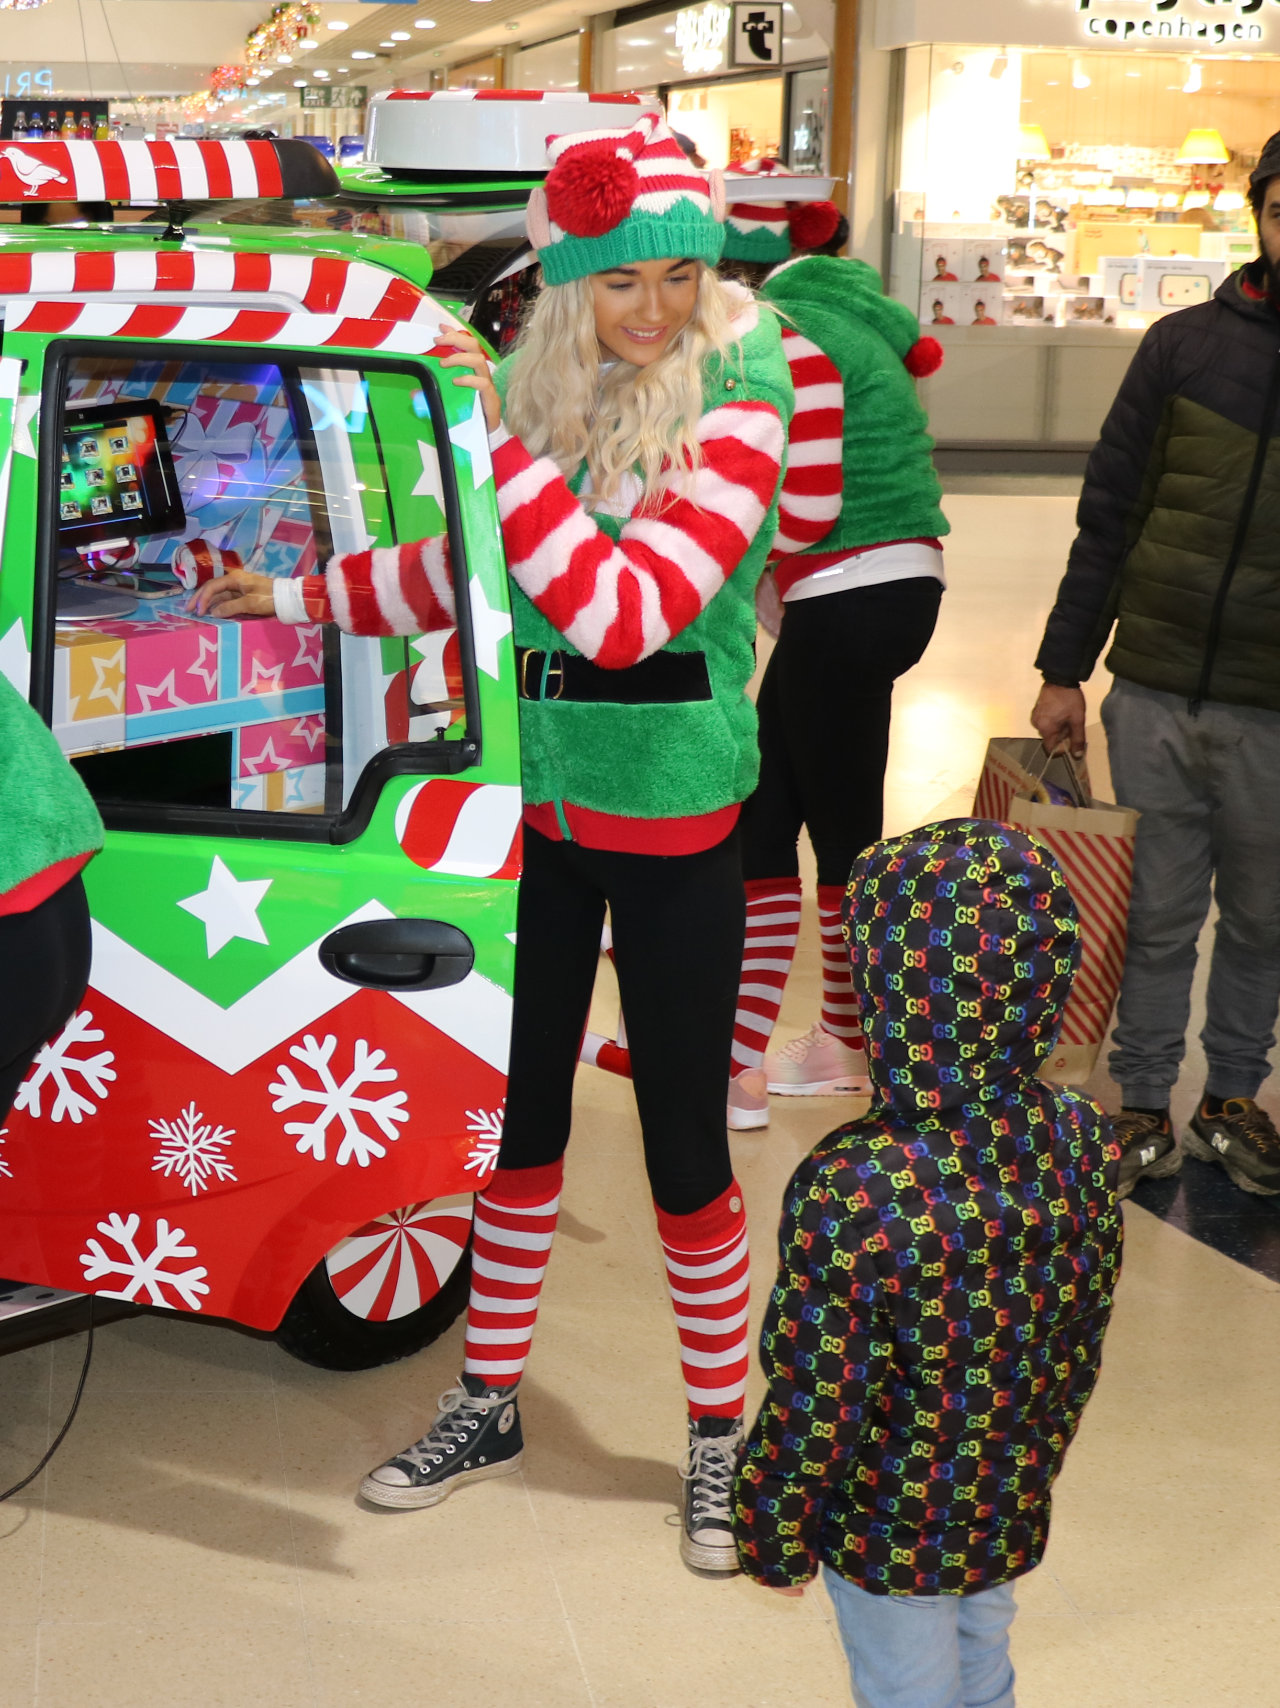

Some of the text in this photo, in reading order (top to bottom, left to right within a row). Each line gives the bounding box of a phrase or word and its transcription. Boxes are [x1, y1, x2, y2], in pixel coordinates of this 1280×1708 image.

[1089, 17, 1262, 43] copenhagen
[303, 88, 325, 97] Fire
[303, 98, 325, 106] exit
